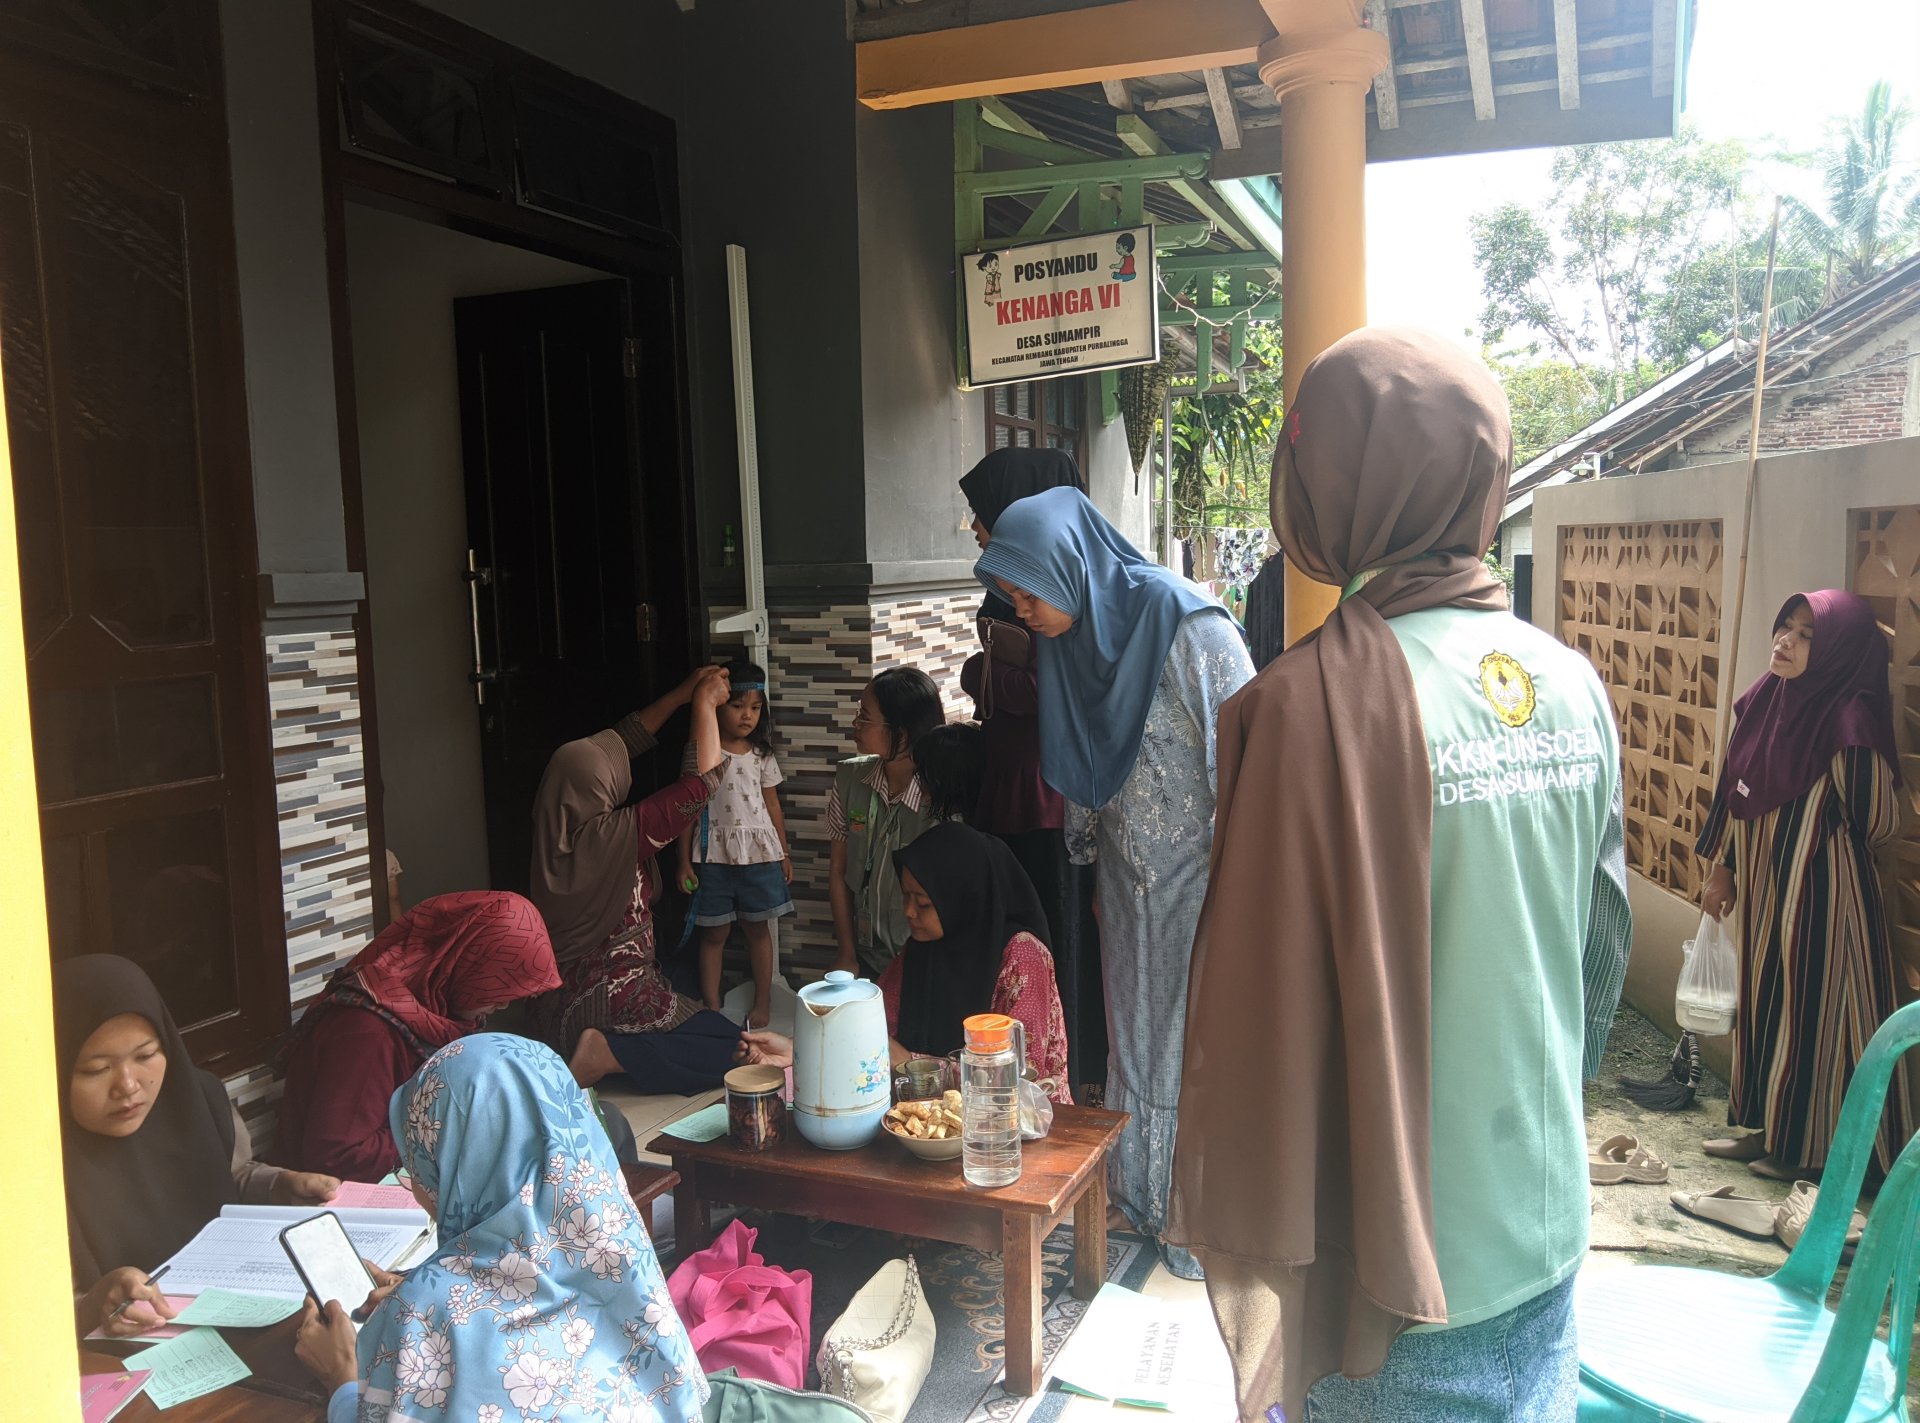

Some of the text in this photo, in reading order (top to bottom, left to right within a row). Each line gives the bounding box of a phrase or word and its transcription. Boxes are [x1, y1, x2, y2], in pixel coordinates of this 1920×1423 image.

[1014, 252, 1098, 283] POSYANDU
[996, 283, 1121, 326] KENANGA VI
[991, 338, 1129, 366] KECAMATAN REMBANG KABUPATEN PURBALINGGA
[1016, 325, 1101, 350] DESA SUMAMPIR
[1039, 355, 1079, 368] JAWA TENGAH
[1439, 775, 1502, 807] DESA
[1134, 1321, 1161, 1384] PELAYANAN
[1156, 1322, 1181, 1386] KESEHATAN
